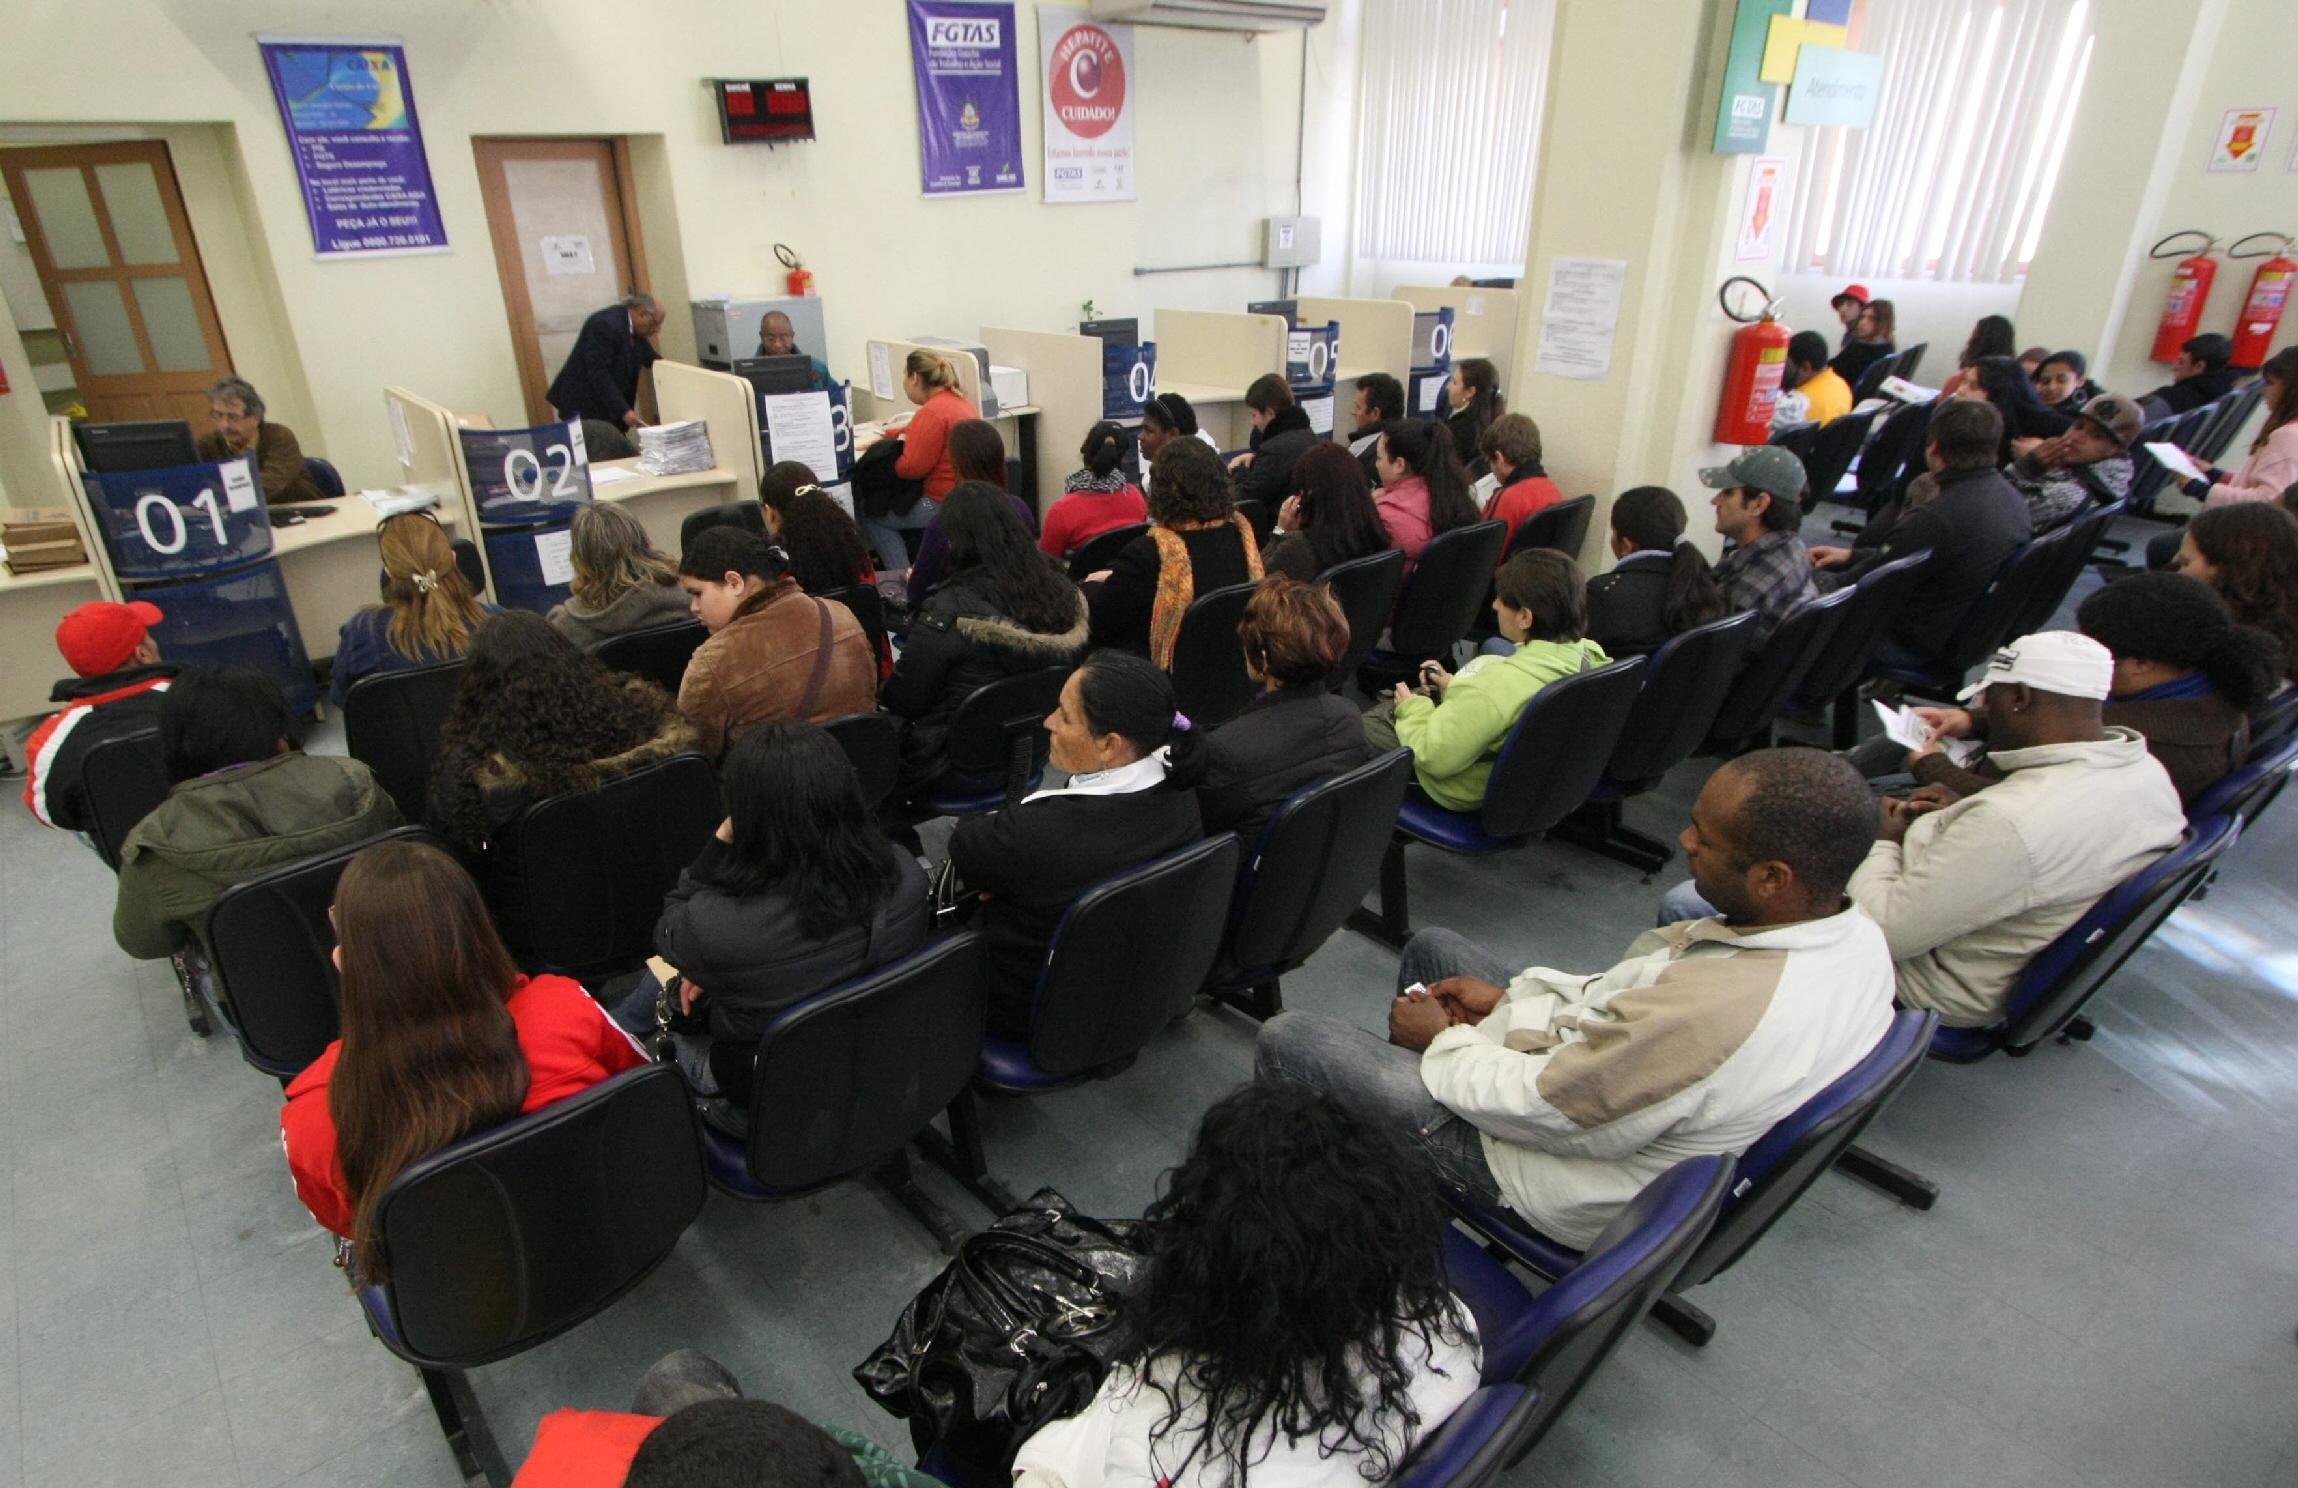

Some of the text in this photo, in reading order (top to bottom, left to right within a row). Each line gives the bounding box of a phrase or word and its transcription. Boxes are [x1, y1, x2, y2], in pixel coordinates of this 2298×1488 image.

[931, 22, 996, 42] FGTAS
[1060, 29, 1115, 65] HEPATITE
[346, 57, 393, 71] CAIXA
[1070, 49, 1099, 99] C
[1061, 105, 1116, 120] CUIDADO!
[335, 217, 365, 230] PEÇA
[366, 216, 379, 229] JÁ
[331, 238, 362, 250] Ligue
[830, 404, 850, 452] 3
[504, 443, 579, 501] 02
[135, 487, 229, 555] 01
